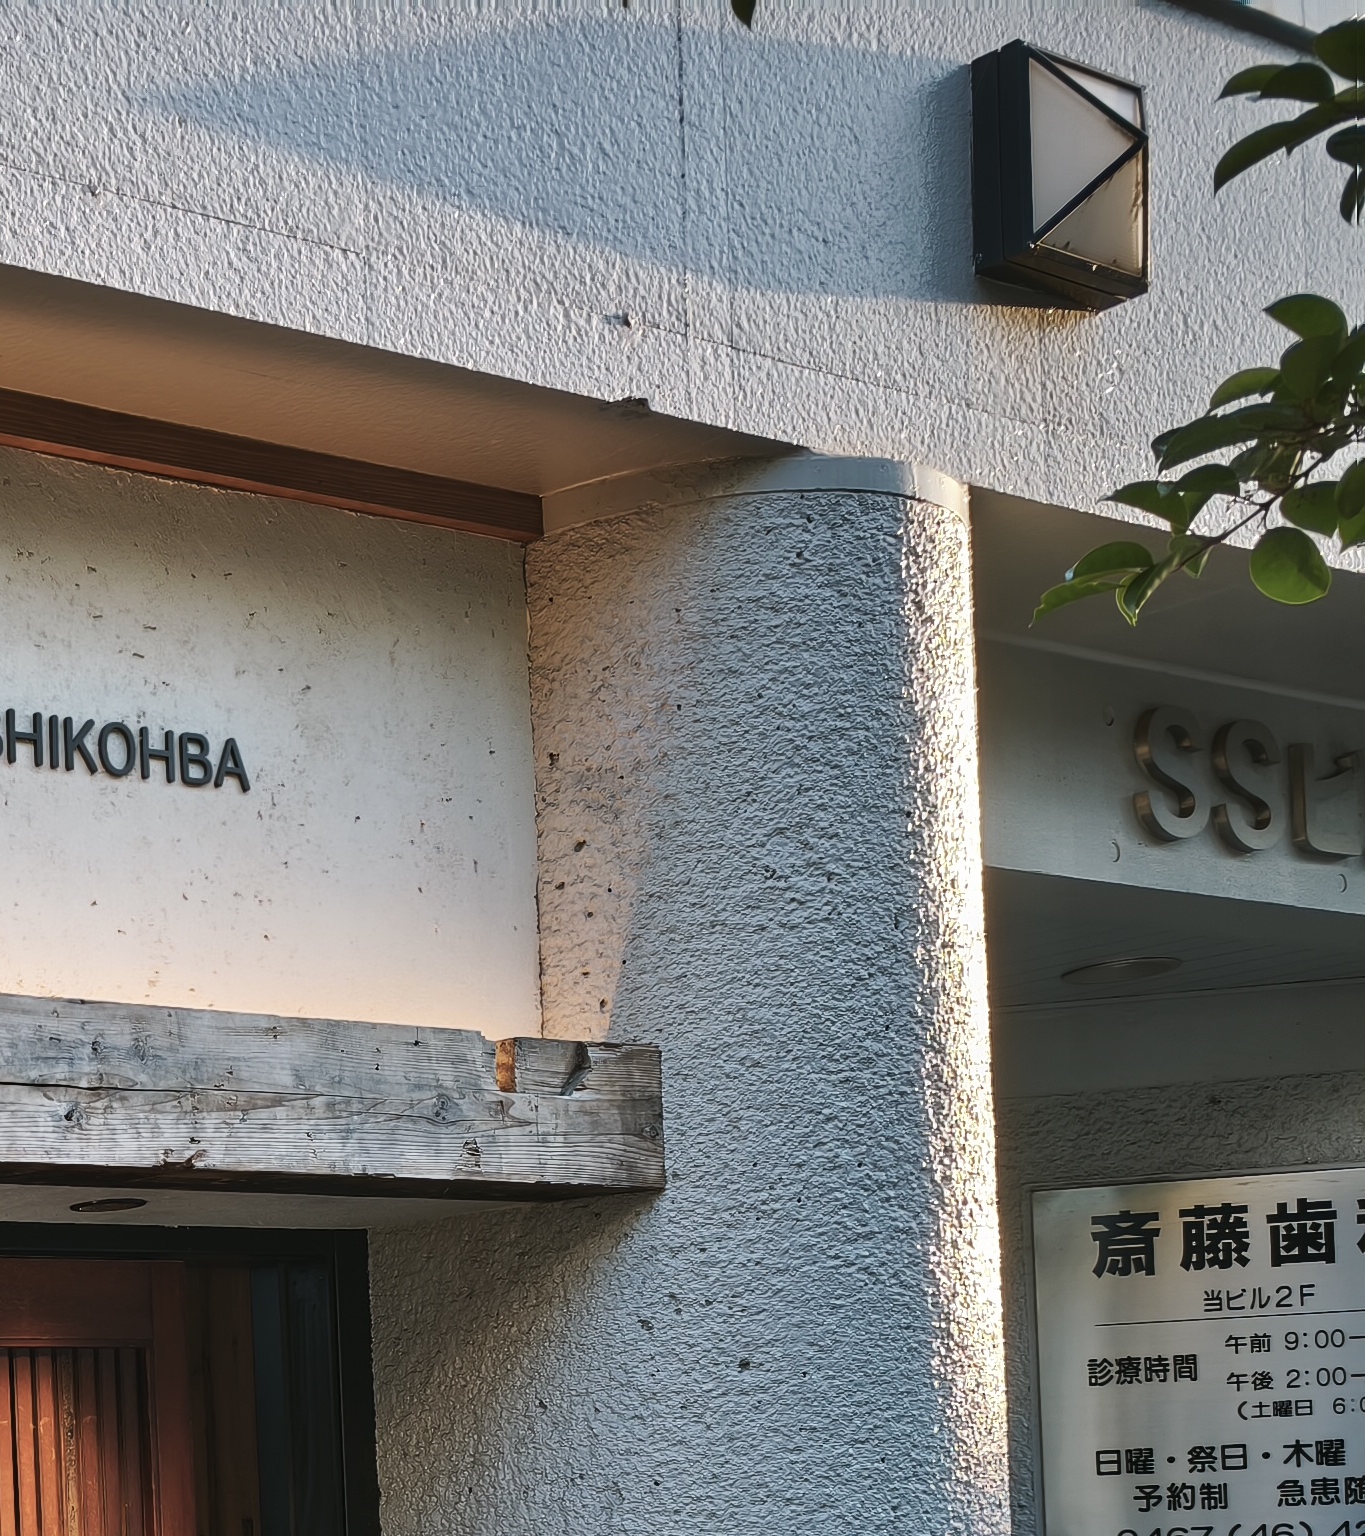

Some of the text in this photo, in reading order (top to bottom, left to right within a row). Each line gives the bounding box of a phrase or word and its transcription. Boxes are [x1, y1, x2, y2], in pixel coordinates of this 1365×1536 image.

[1090, 1197, 1365, 1279] 斎藤歯
[1224, 1333, 1272, 1355] 午前
[1086, 1353, 1199, 1387] 診療時間
[1226, 1371, 1274, 1392] 午後
[1133, 1481, 1229, 1513] 予約制
